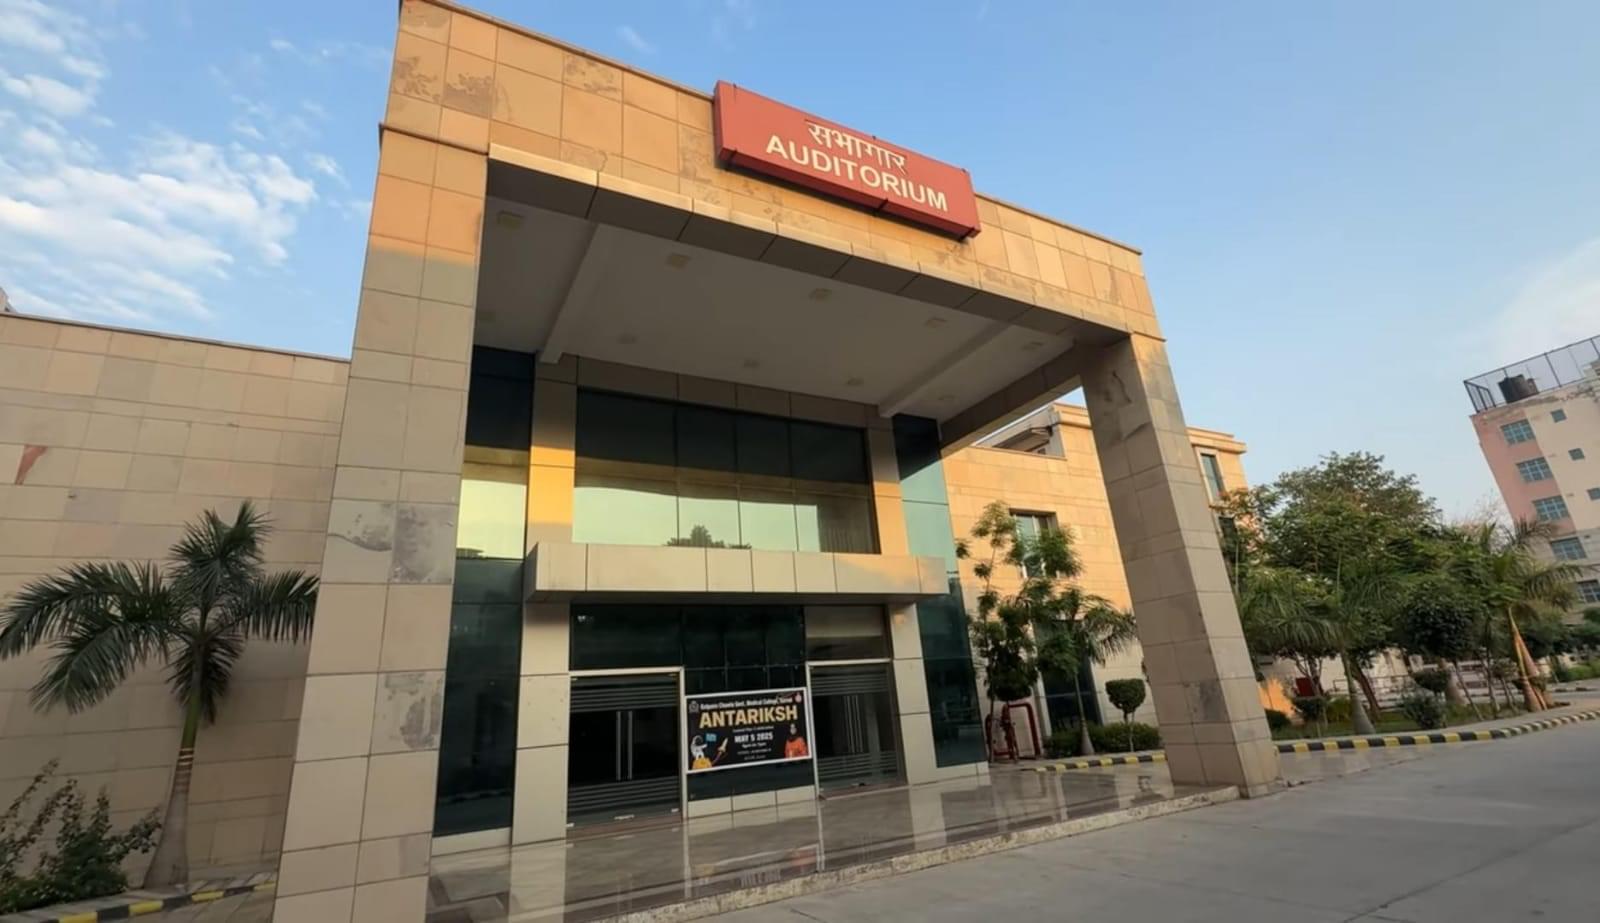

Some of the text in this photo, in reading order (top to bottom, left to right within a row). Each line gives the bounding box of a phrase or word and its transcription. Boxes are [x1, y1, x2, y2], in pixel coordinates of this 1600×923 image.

[765, 135, 948, 212] AUDITORIUM
[806, 121, 907, 175] सभागार
[699, 705, 798, 729] ANTARIKSH
